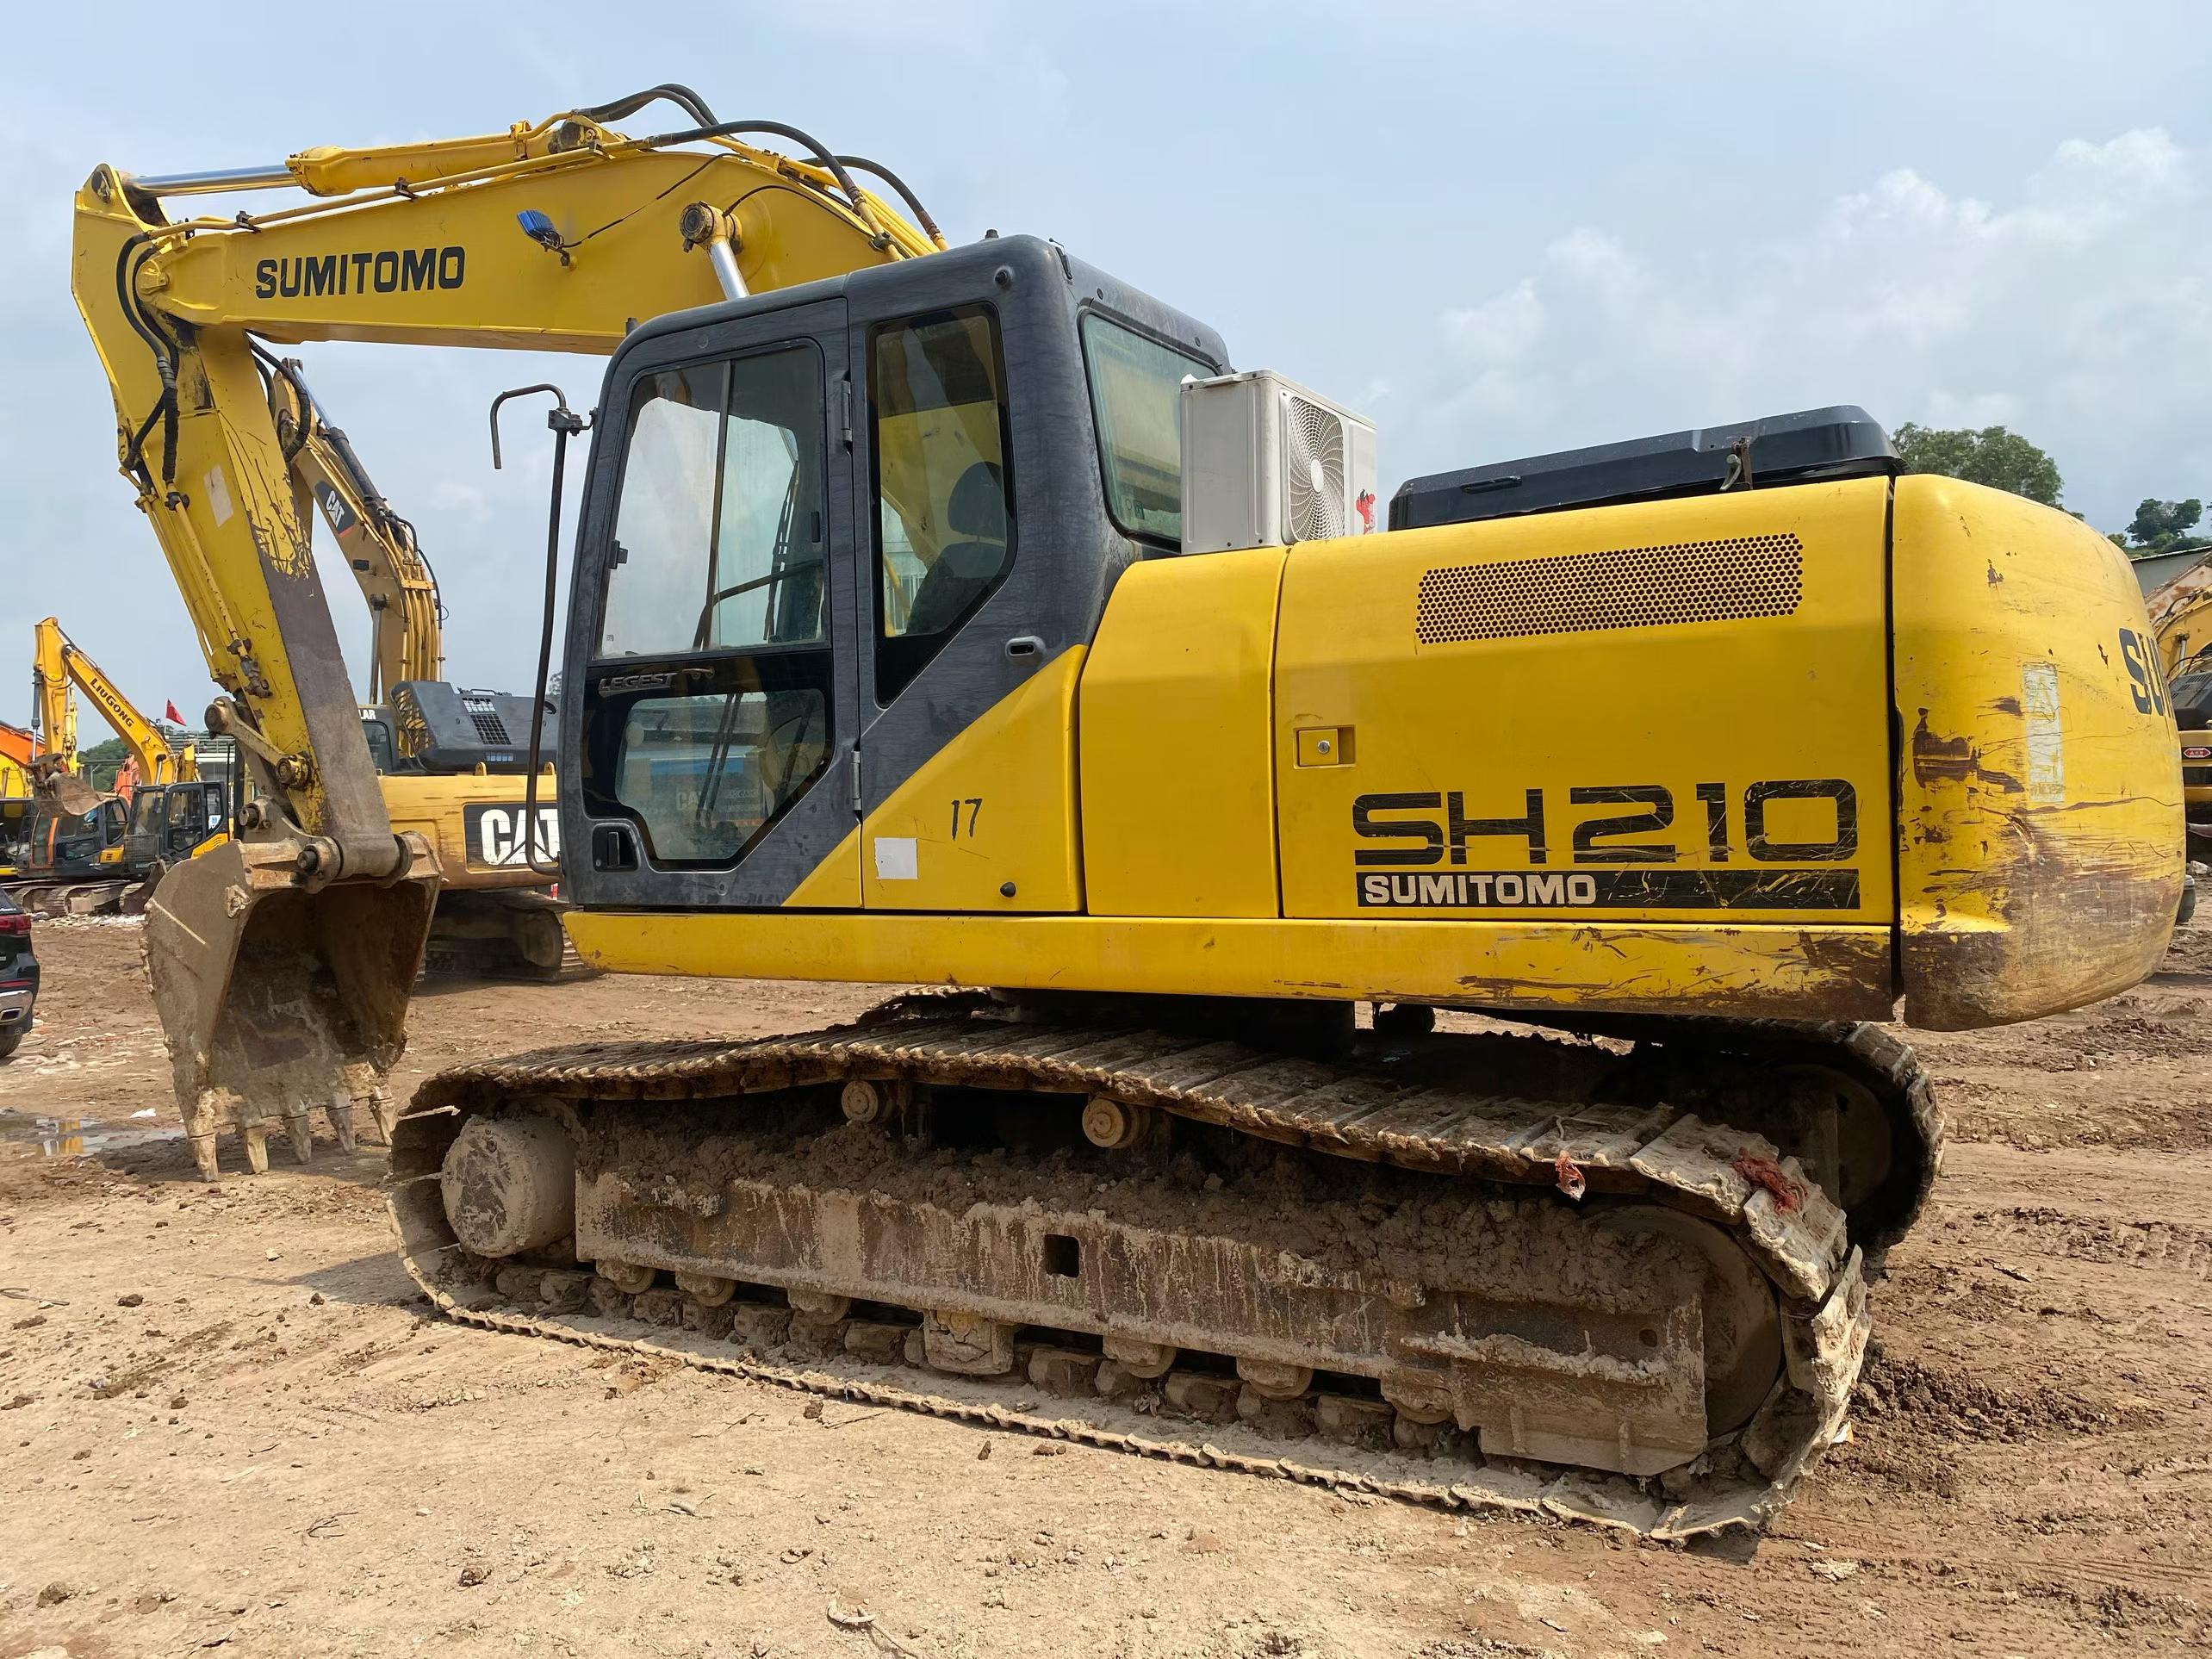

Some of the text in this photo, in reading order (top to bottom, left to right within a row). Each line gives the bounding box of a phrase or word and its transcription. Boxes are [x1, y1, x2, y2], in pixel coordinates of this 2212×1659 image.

[256, 246, 466, 298] SUMITOMO
[326, 490, 345, 528] CAT
[599, 673, 678, 692] LEGEST
[2119, 628, 2174, 718] SU
[481, 808, 561, 866] CAT
[951, 798, 984, 841] 17
[1364, 874, 1597, 905] SUMITOMO
